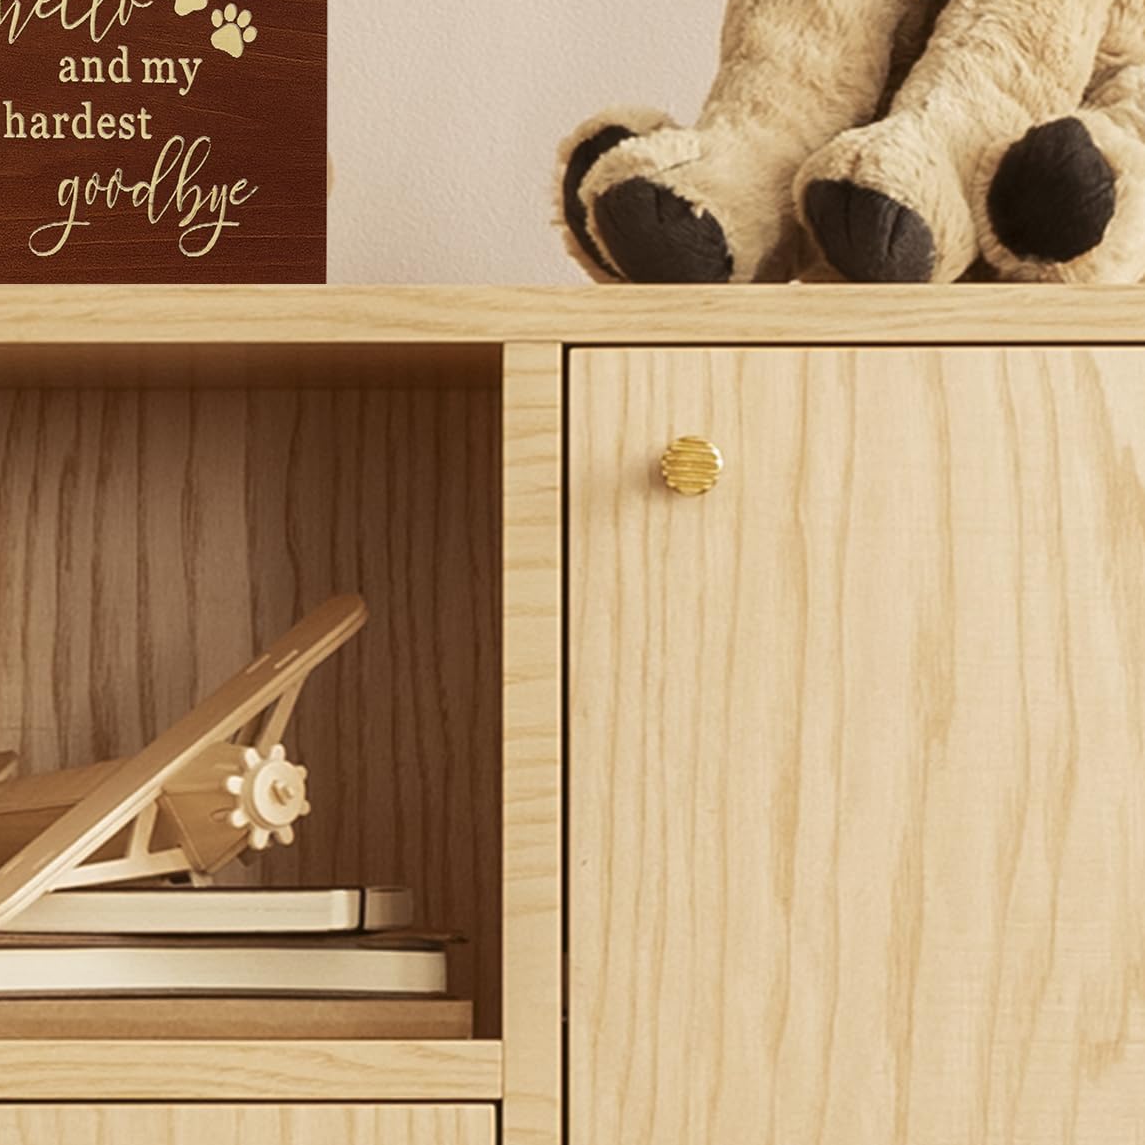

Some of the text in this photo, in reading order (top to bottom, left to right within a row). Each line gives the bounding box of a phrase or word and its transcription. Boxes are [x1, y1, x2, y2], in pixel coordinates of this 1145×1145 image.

[59, 46, 202, 95] and my
[3, 101, 152, 139] hardest
[29, 135, 258, 257] goodbye
